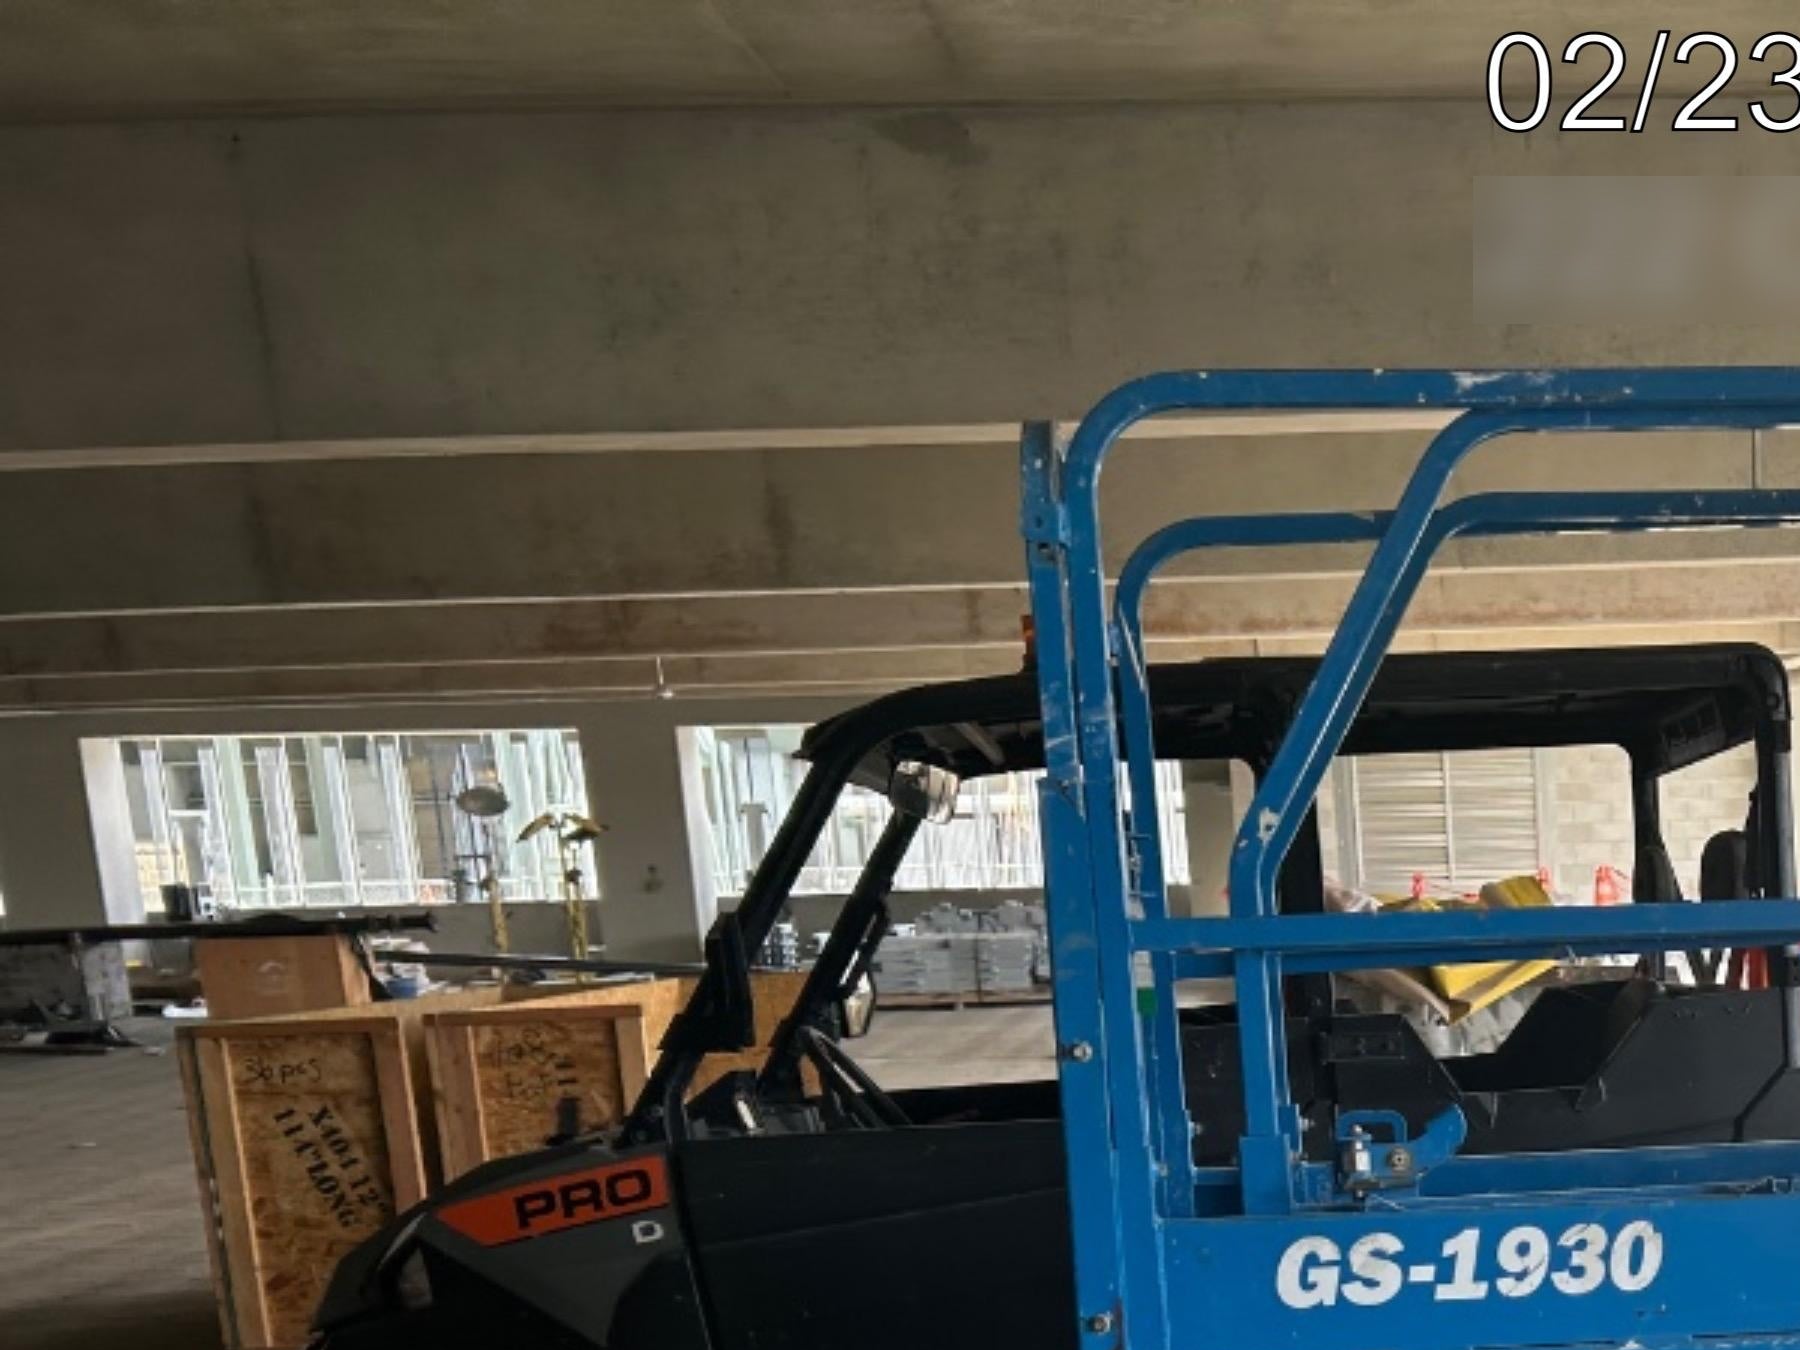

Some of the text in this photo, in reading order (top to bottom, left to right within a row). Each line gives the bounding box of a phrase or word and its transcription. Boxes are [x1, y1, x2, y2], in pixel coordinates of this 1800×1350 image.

[513, 1169, 652, 1229] PRO
[632, 1220, 664, 1243] D
[1276, 1220, 1663, 1309] GS-1930
